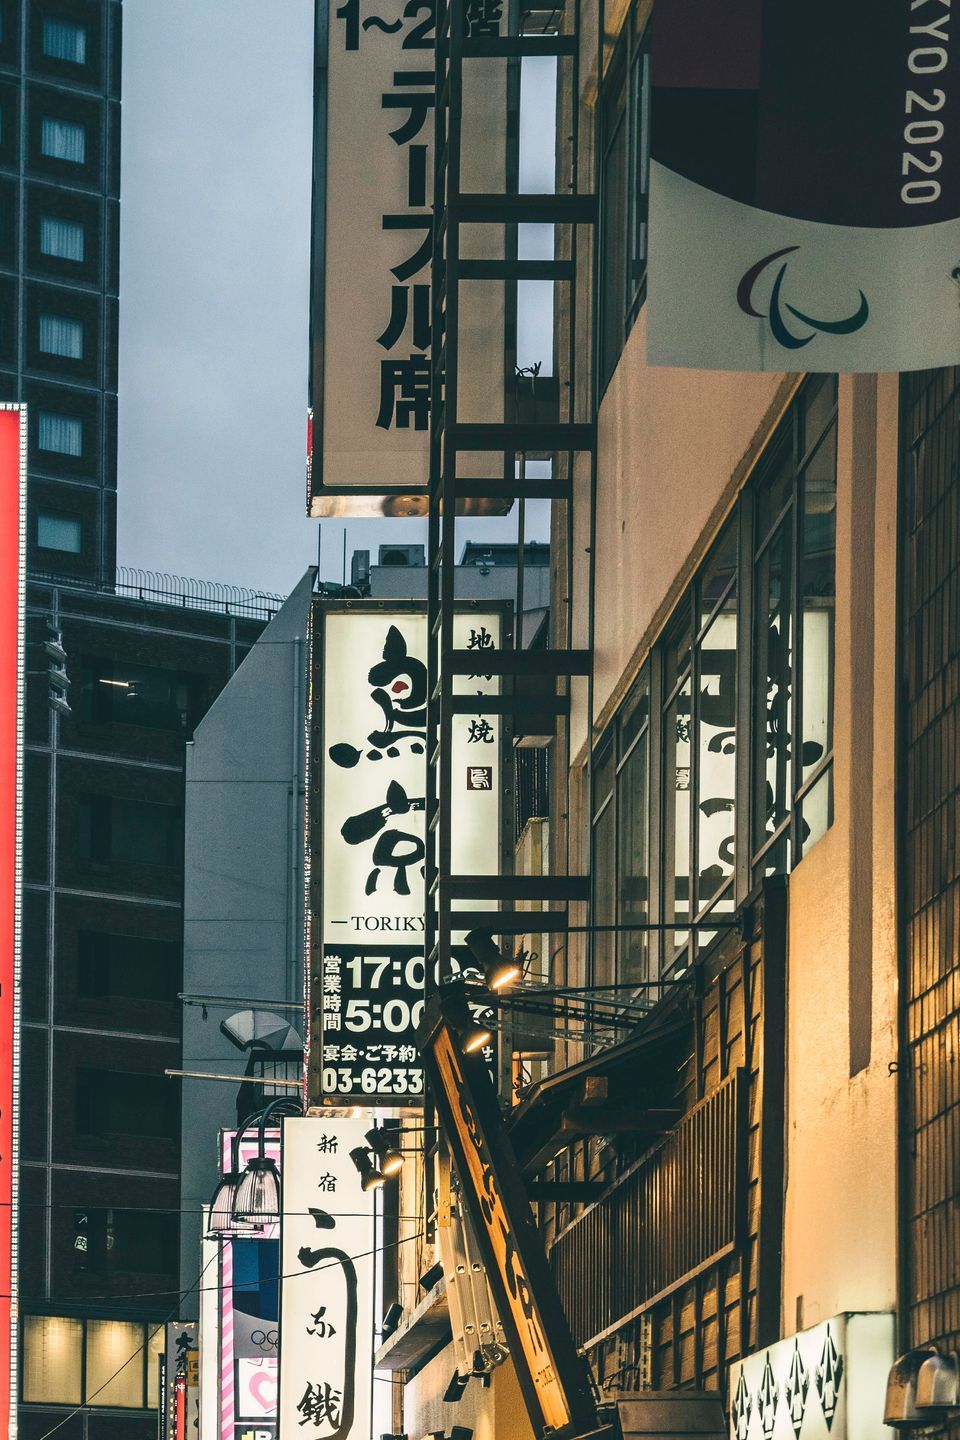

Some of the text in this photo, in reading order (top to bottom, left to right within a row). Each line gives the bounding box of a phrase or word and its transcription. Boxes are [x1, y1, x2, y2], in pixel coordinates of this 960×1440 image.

[900, 88, 946, 205] 2020
[324, 955, 342, 1032] 営業時間
[316, 1133, 338, 1194] 新宿
